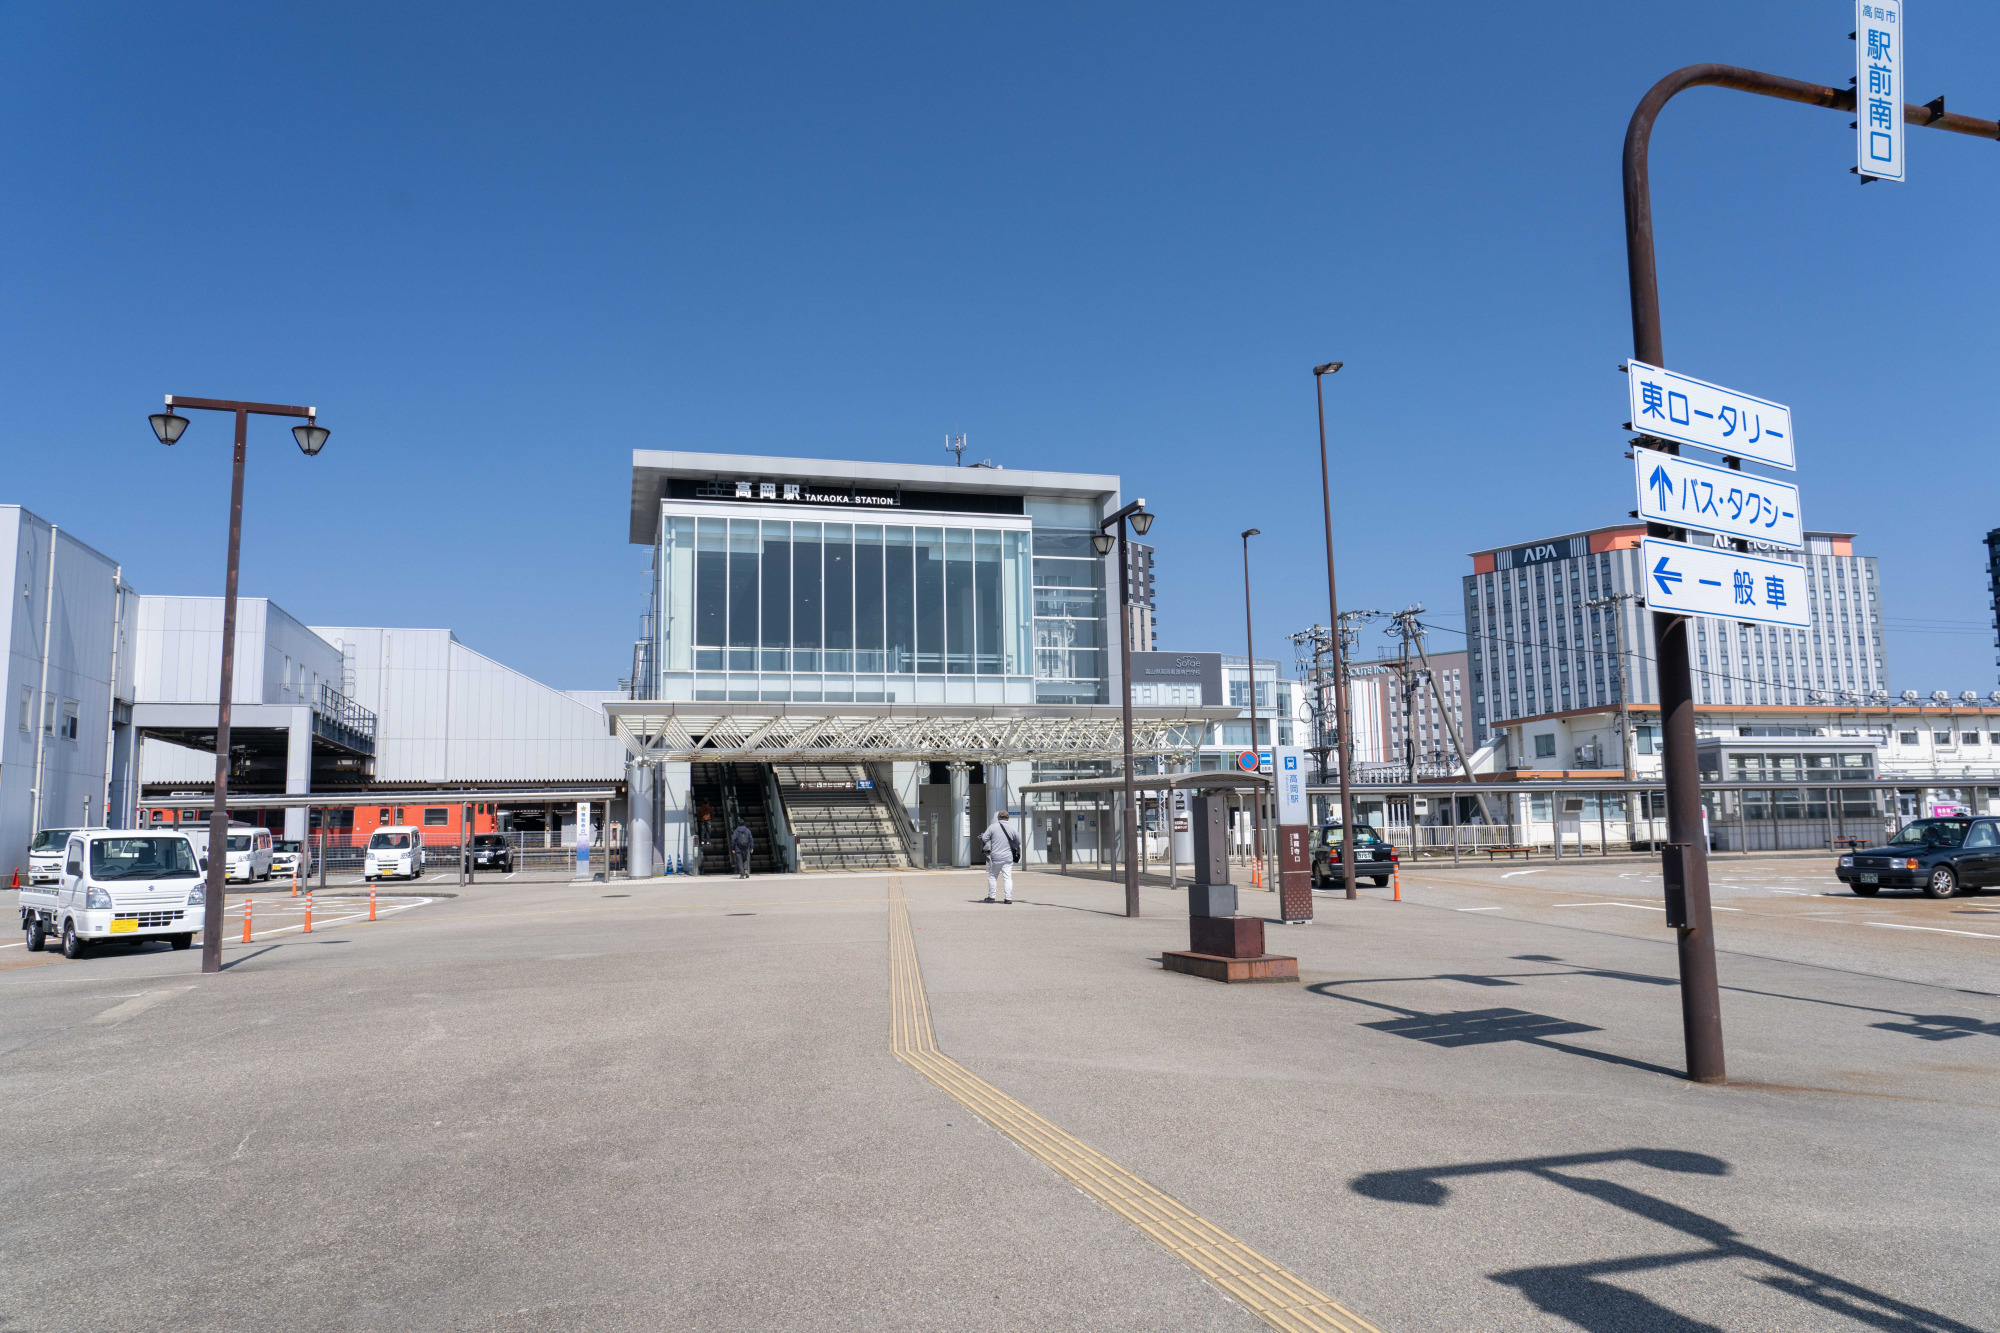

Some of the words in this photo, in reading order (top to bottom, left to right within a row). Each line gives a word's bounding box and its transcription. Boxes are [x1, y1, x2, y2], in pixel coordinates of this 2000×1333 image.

[1862, 5, 1896, 24] 高岡市
[1867, 28, 1893, 163] 駅前南口
[1640, 381, 1784, 444] 東ロータリー
[736, 481, 800, 500] 高岡駅
[804, 493, 849, 503] TAKAOKA
[855, 496, 894, 505] STATION
[1682, 477, 1794, 528] バス・タクシー
[1523, 544, 1558, 563] APA
[1698, 569, 1787, 610] 一般車
[1348, 665, 1372, 678] OUTE
[1290, 774, 1299, 803] 高岡駅
